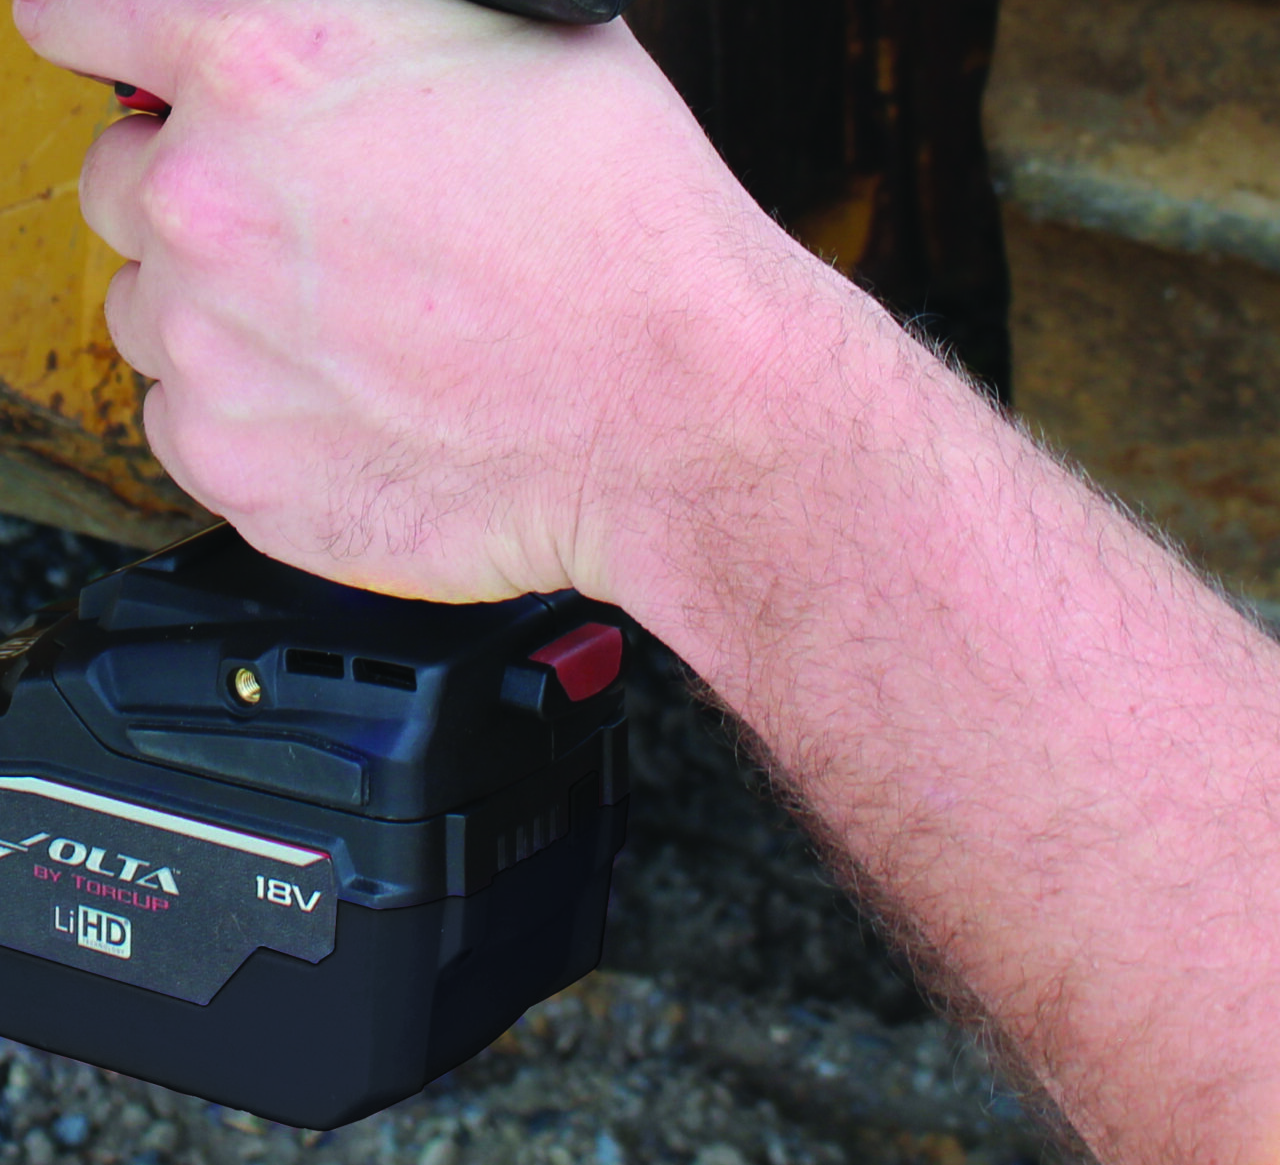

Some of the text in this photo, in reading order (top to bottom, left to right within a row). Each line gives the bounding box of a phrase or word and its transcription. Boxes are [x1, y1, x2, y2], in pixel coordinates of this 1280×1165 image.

[33, 864, 170, 912] BY TORCUP
[255, 874, 322, 913] 18V
